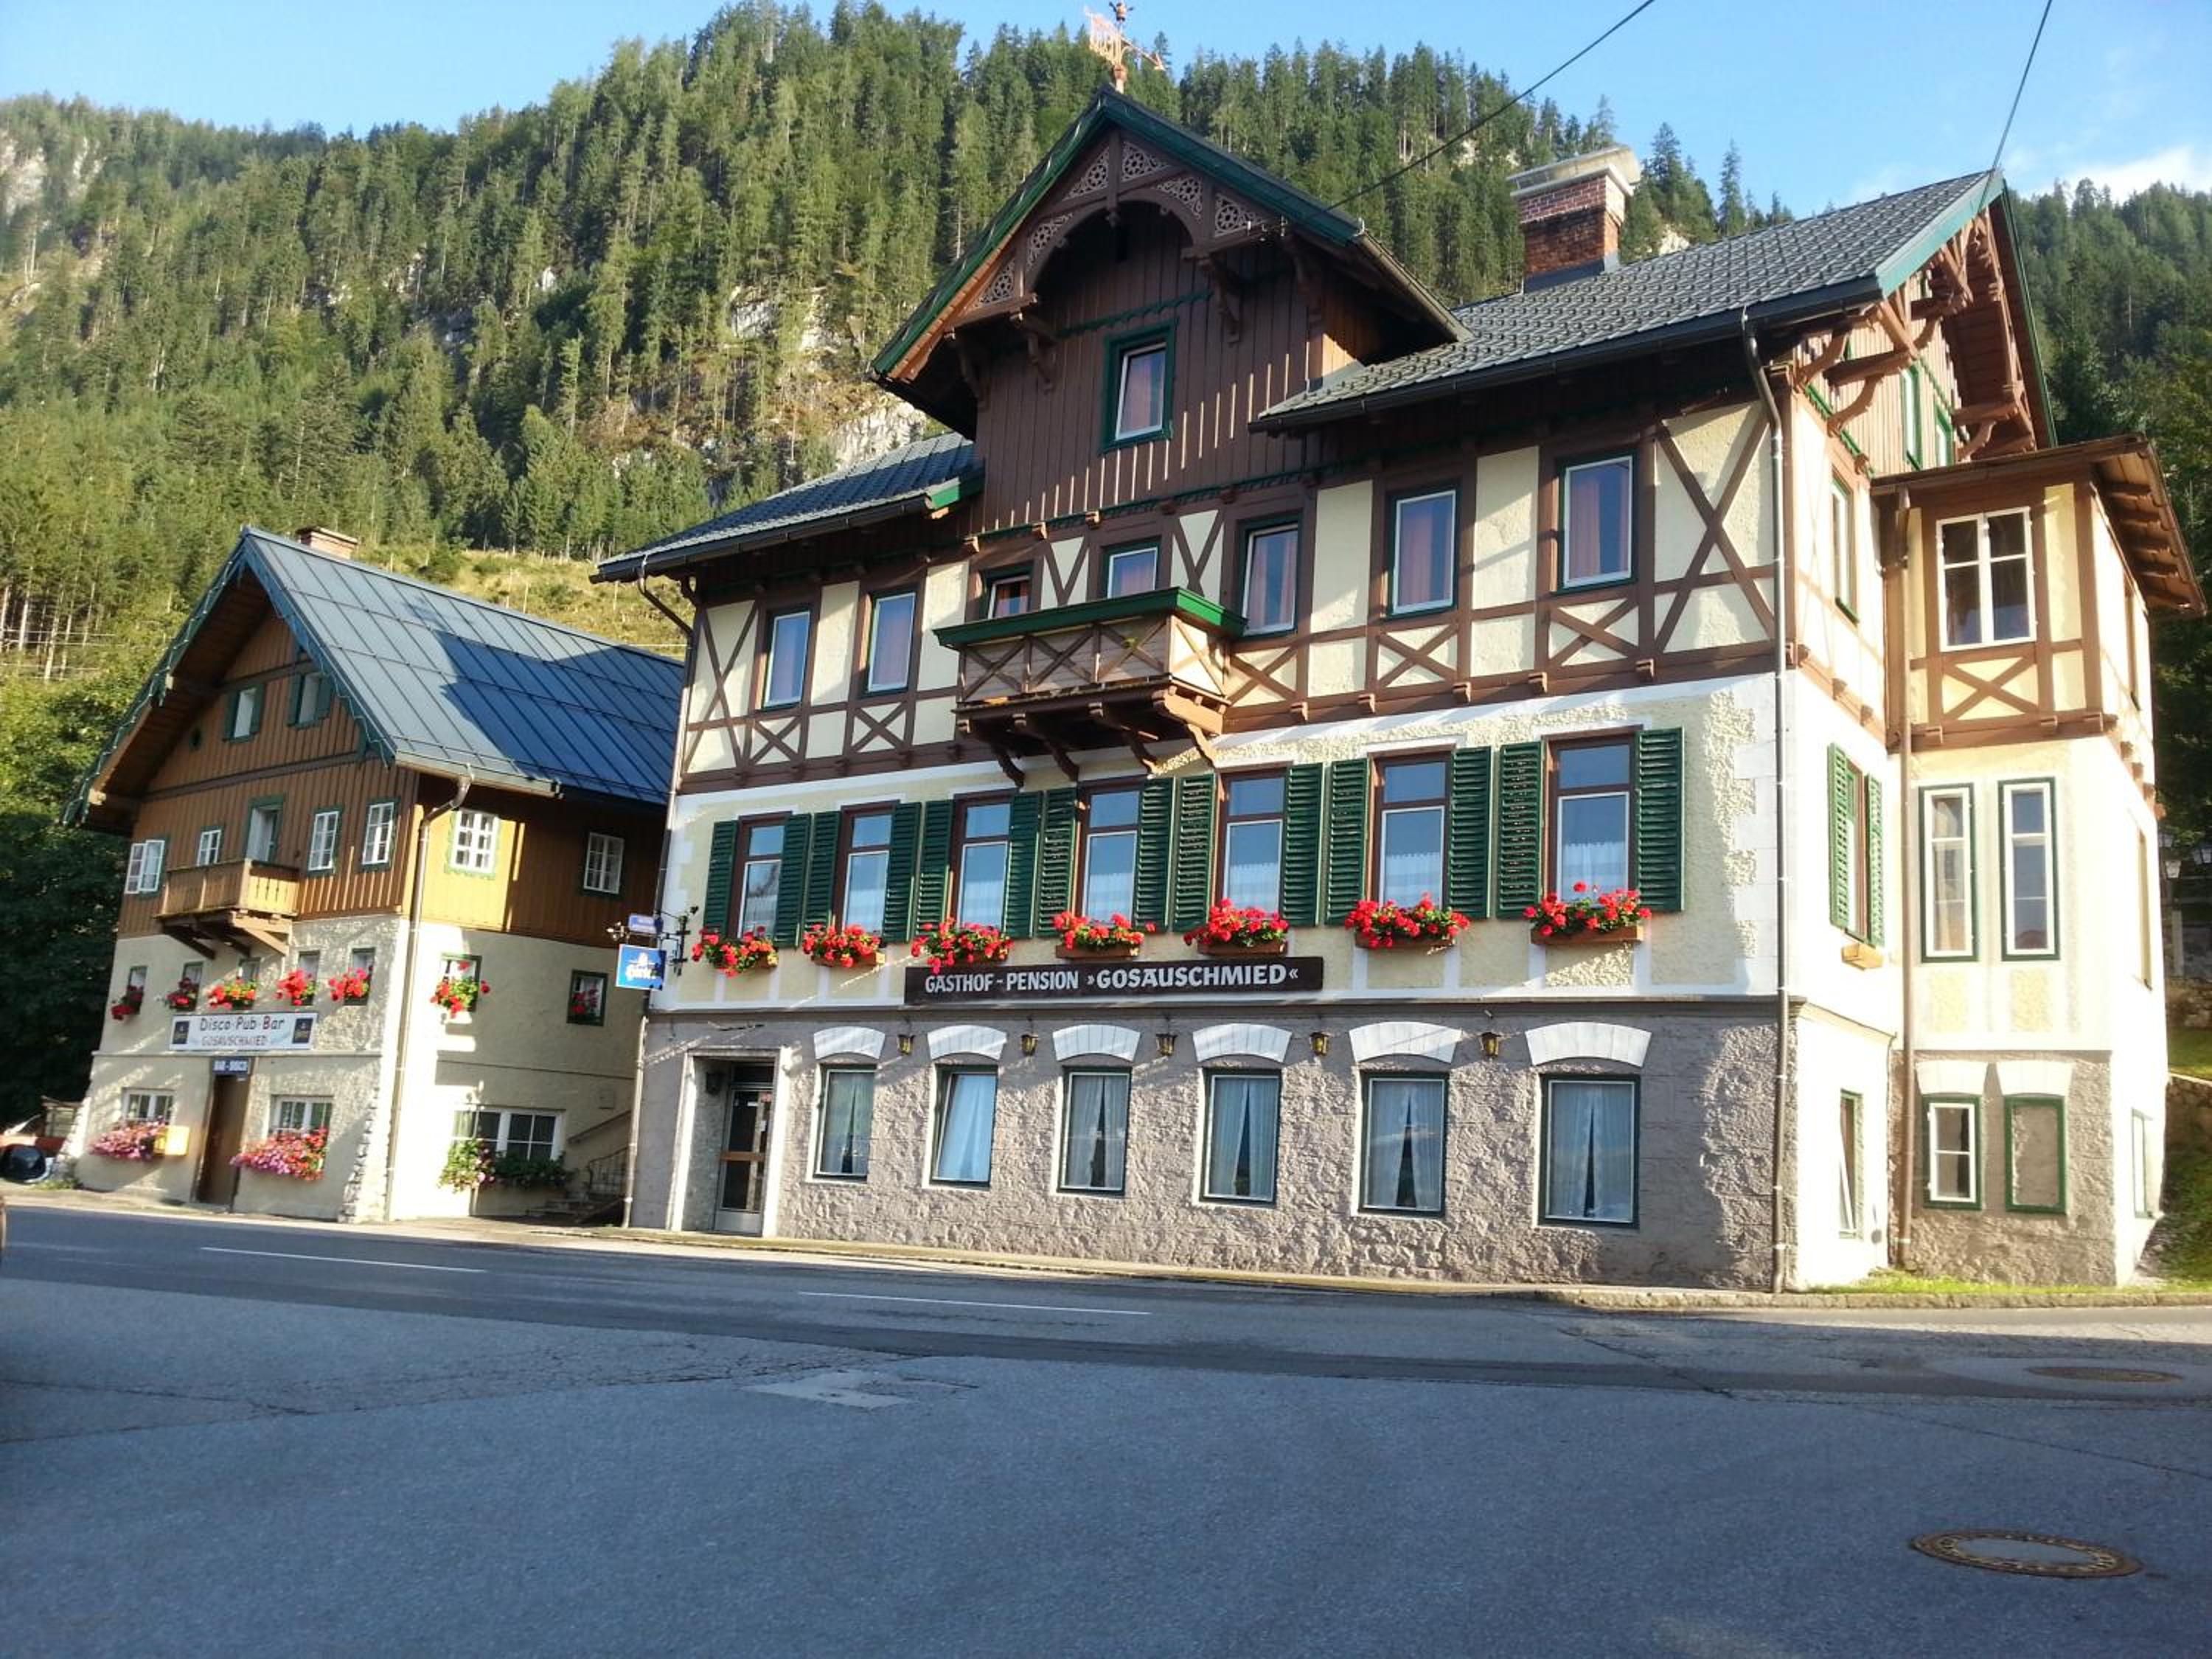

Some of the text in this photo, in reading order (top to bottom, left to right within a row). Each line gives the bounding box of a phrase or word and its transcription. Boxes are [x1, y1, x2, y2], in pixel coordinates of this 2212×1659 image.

[925, 973, 994, 993] GASTHOF
[1006, 970, 1079, 991] PENSION
[200, 1015, 285, 1032] Disco Pub Bar
